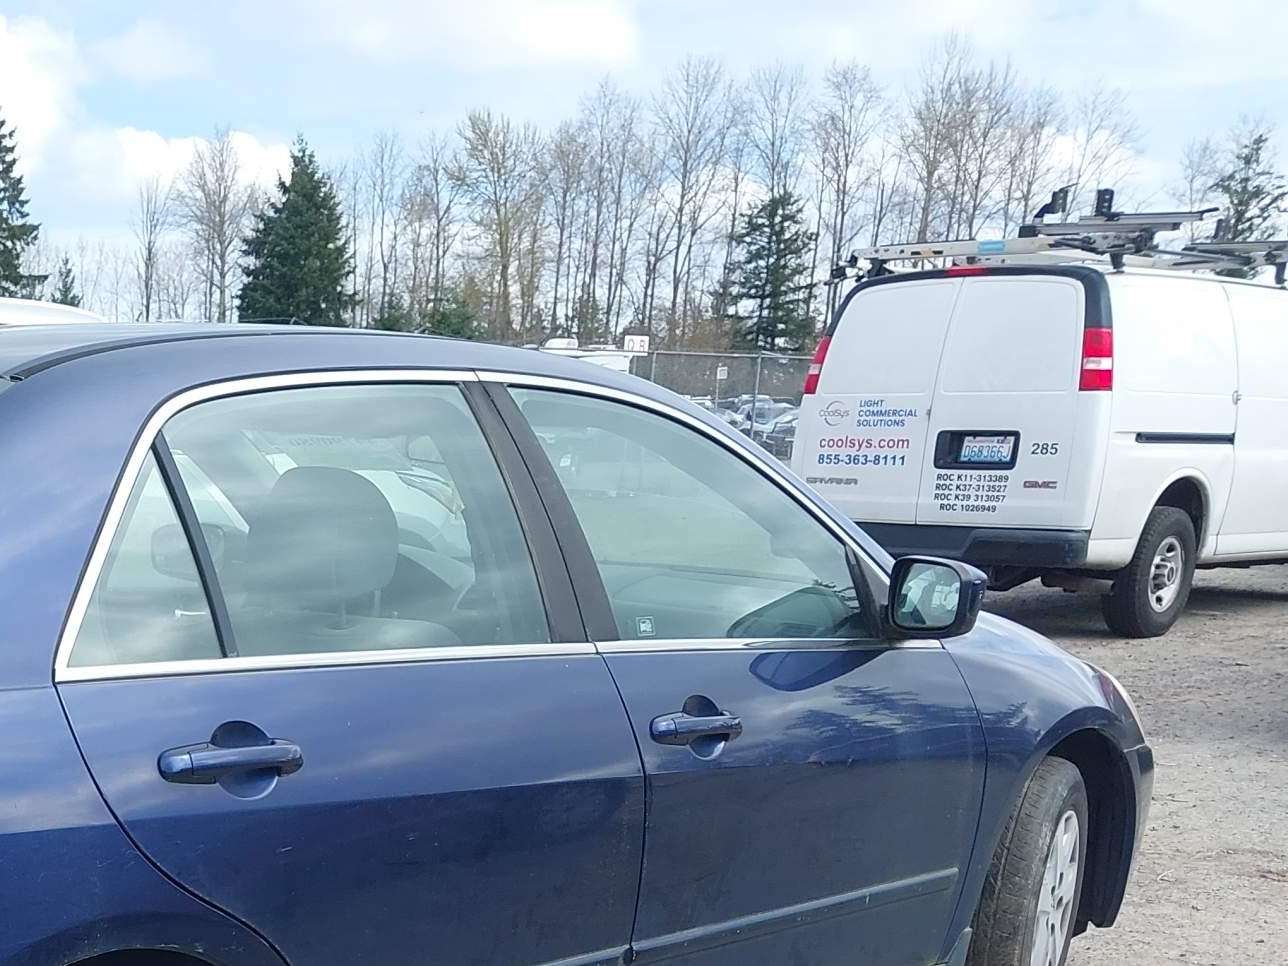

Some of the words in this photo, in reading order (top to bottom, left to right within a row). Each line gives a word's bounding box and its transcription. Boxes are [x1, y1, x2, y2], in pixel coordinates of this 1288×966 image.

[859, 399, 885, 408] LIGHT
[857, 409, 918, 417] COMMERCIAL
[856, 418, 906, 428] SOLUTIONS
[819, 434, 910, 452] coolsys.com
[1031, 442, 1060, 455] 285
[817, 453, 906, 466] 855-363-8111
[936, 473, 955, 482] ROC
[956, 473, 1009, 483] K11-313389
[935, 483, 953, 491] ROC
[955, 483, 1008, 493] K37-313527
[1023, 480, 1058, 489] GMC
[933, 493, 952, 501] ROC
[953, 493, 971, 502] K39
[973, 494, 1006, 503] 313057
[939, 503, 958, 511] ROC
[960, 504, 997, 513] 1026949
